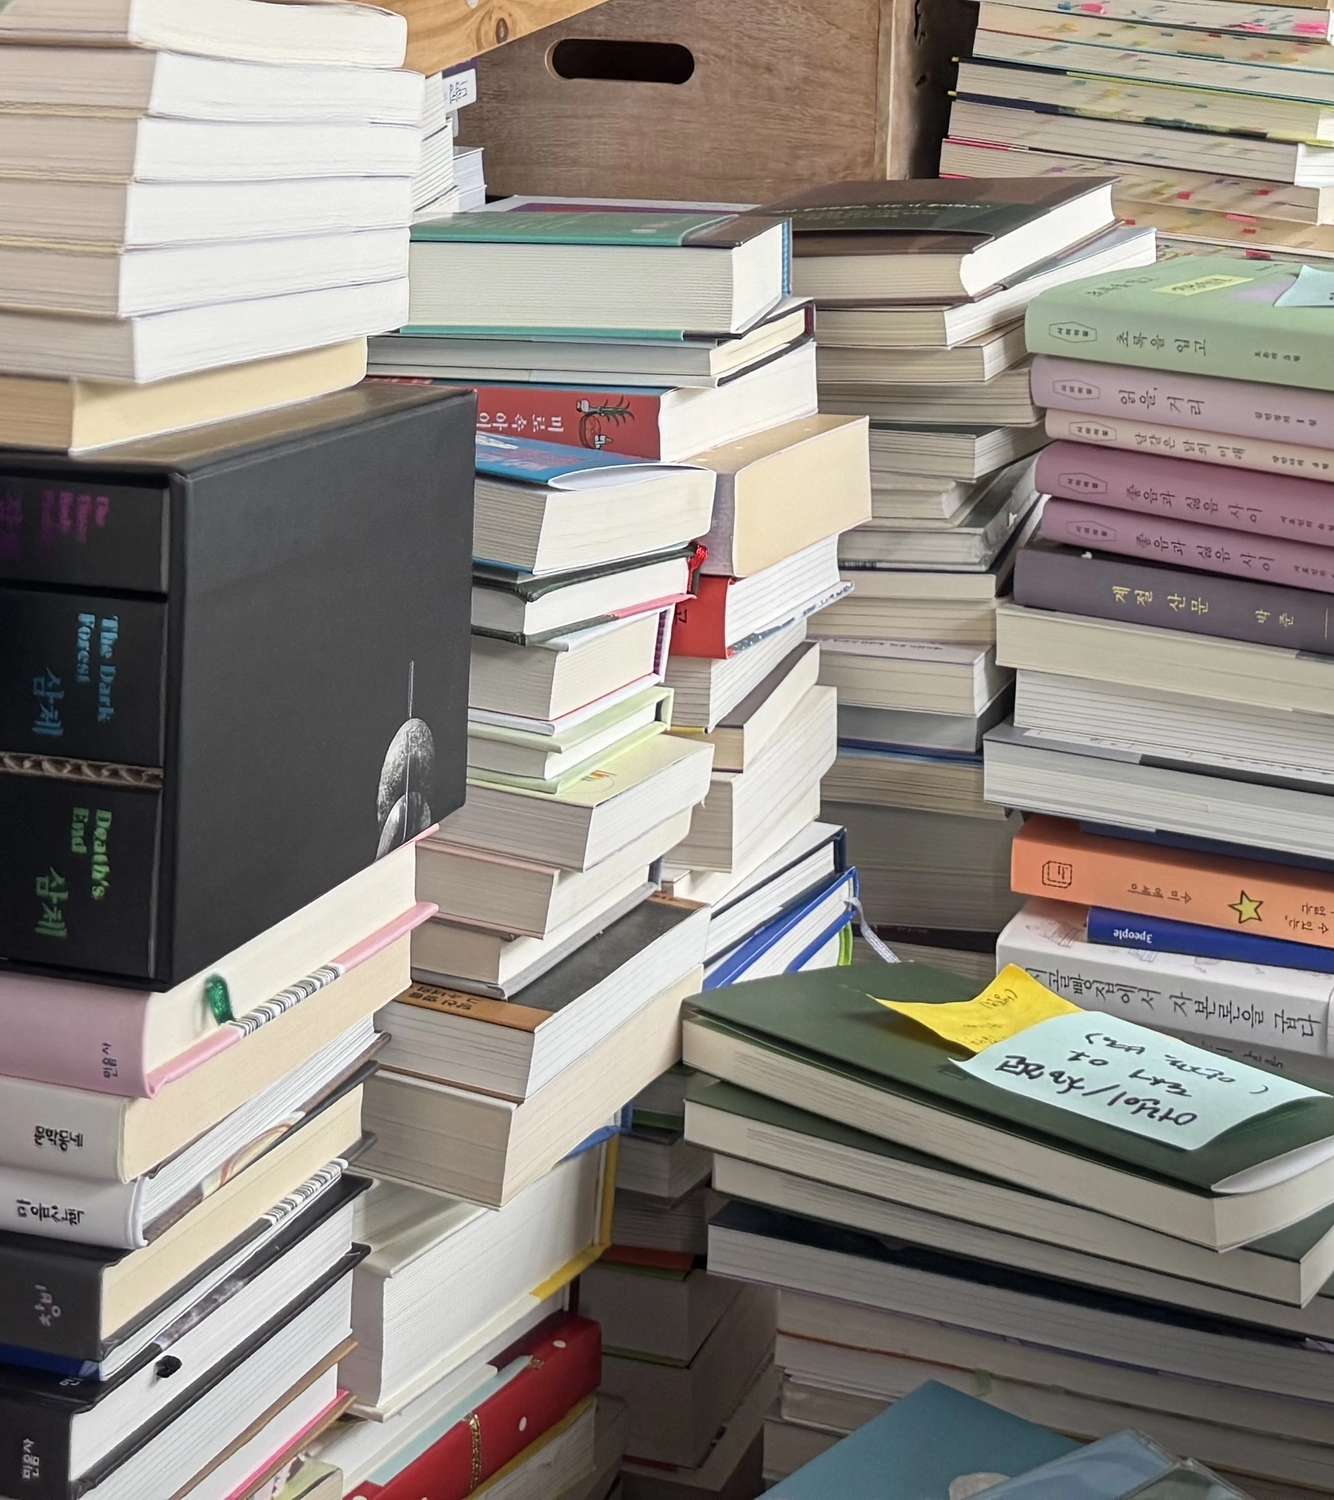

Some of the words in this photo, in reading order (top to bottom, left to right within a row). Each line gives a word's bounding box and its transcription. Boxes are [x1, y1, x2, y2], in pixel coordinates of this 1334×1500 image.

[1116, 331, 1165, 352] 초록을
[1175, 337, 1207, 357] 입고
[475, 411, 508, 431] 아이
[1119, 386, 1158, 409] 읽을,
[1167, 395, 1206, 417] 거리
[510, 413, 528, 432] 속
[532, 413, 564, 433] 미로
[1126, 483, 1176, 508] 좋음과
[1185, 495, 1219, 515] 싫음
[1228, 502, 1264, 524] 사이
[1136, 531, 1186, 557] 좋음과
[1196, 544, 1232, 563] 싫음
[1240, 551, 1276, 572] 사이
[1112, 584, 1154, 605] 계절
[1167, 593, 1210, 615] 산문
[75, 612, 96, 684] Forest
[98, 615, 120, 659] The
[30, 666, 66, 739] 삼체
[96, 665, 119, 723] Dark
[70, 806, 91, 854] End
[89, 808, 114, 901] Death's
[34, 866, 69, 939] 삼체
[1167, 889, 1192, 905] 수미
[1301, 902, 1327, 917] 없는
[1112, 928, 1153, 945] 3people
[1318, 921, 1330, 935] 수
[1024, 966, 1162, 1010] 시골빵집에서
[1168, 990, 1265, 1029] 자본론을
[1273, 1008, 1323, 1038] 굽다
[99, 1041, 118, 1080] 민음사
[33, 1125, 85, 1153] 문학동네
[15, 1197, 85, 1226] 마음산책
[36, 1285, 63, 1328] 창비
[20, 1438, 39, 1480] 민음사
